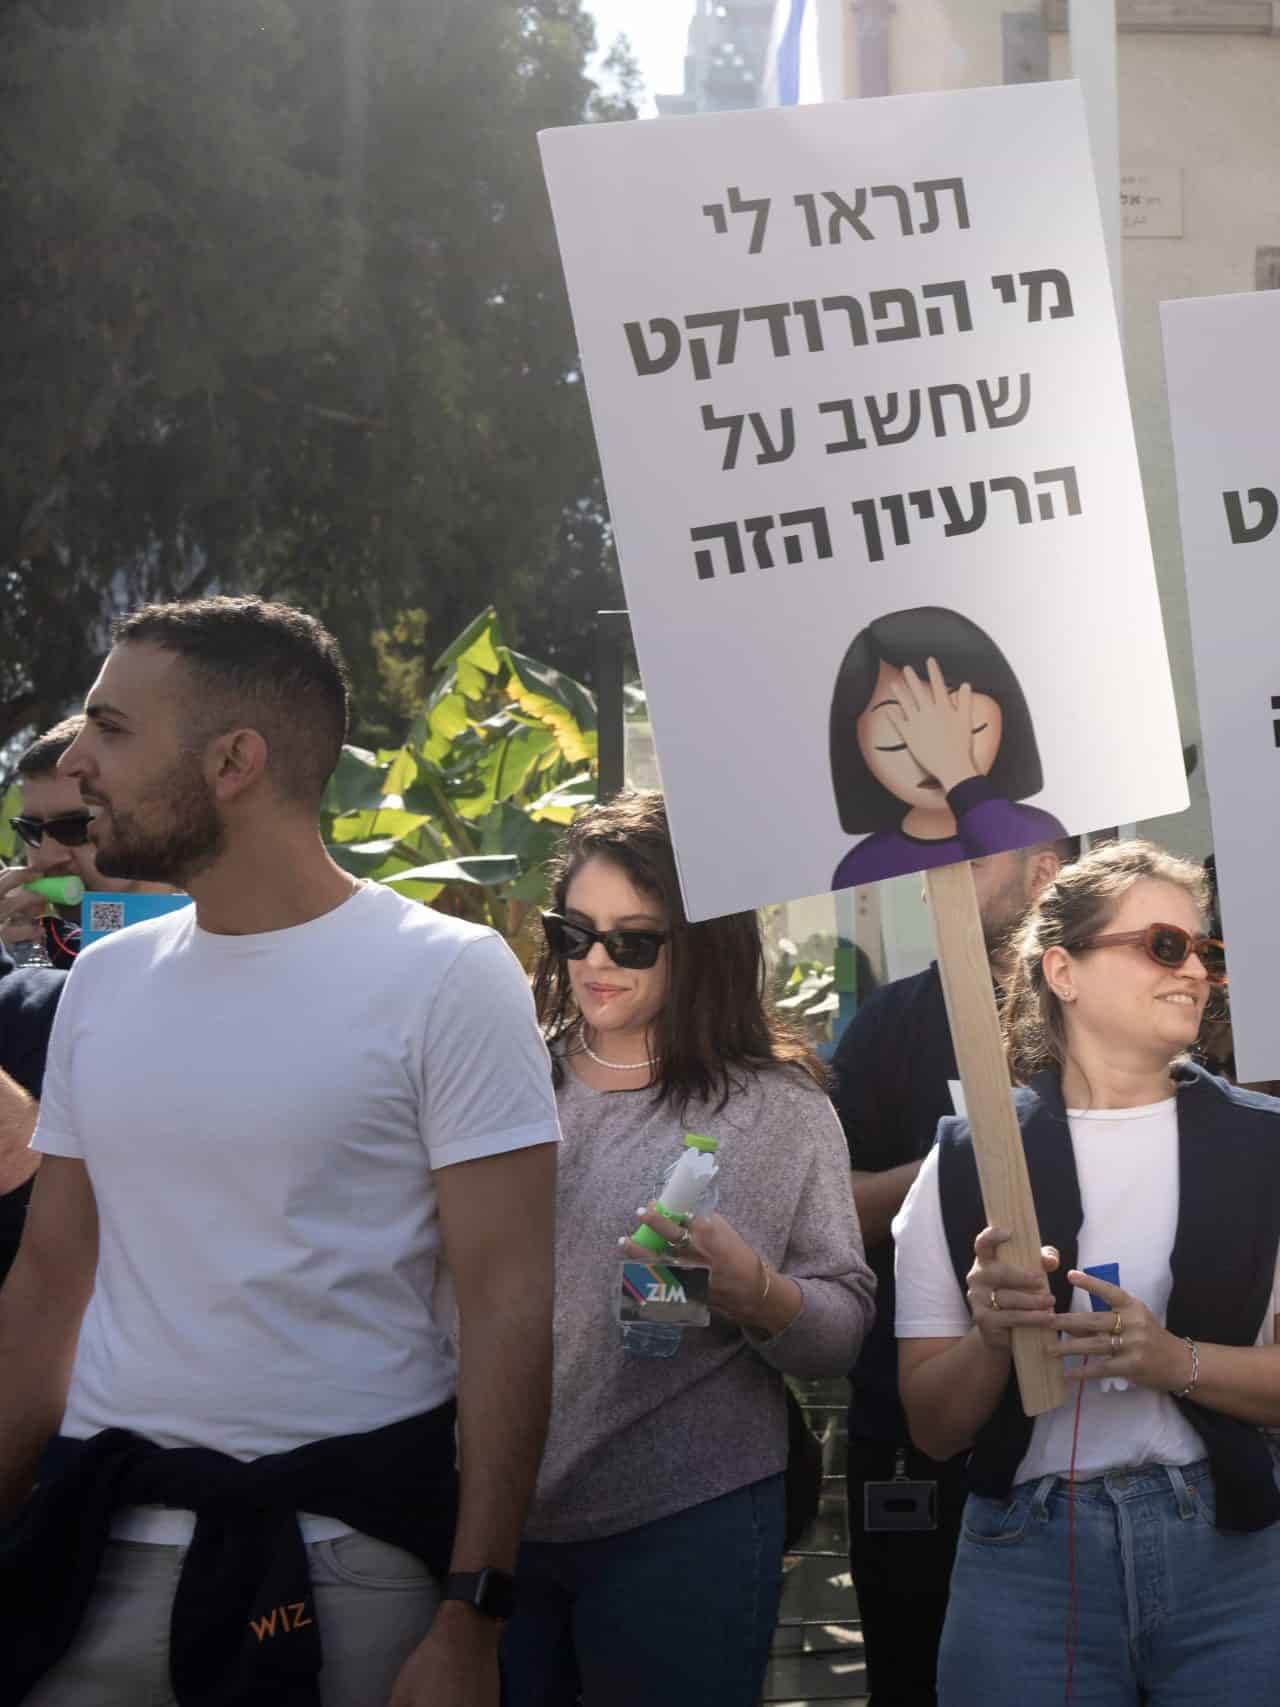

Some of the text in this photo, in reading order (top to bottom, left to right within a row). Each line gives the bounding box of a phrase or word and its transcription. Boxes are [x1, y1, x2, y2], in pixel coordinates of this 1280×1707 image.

[701, 176, 971, 255] תראו לי
[623, 268, 1075, 381] מי הפרודקט
[699, 372, 1031, 472] שחשב על
[689, 465, 1083, 581] הרעיון הזה
[247, 1601, 313, 1643] WIZ
